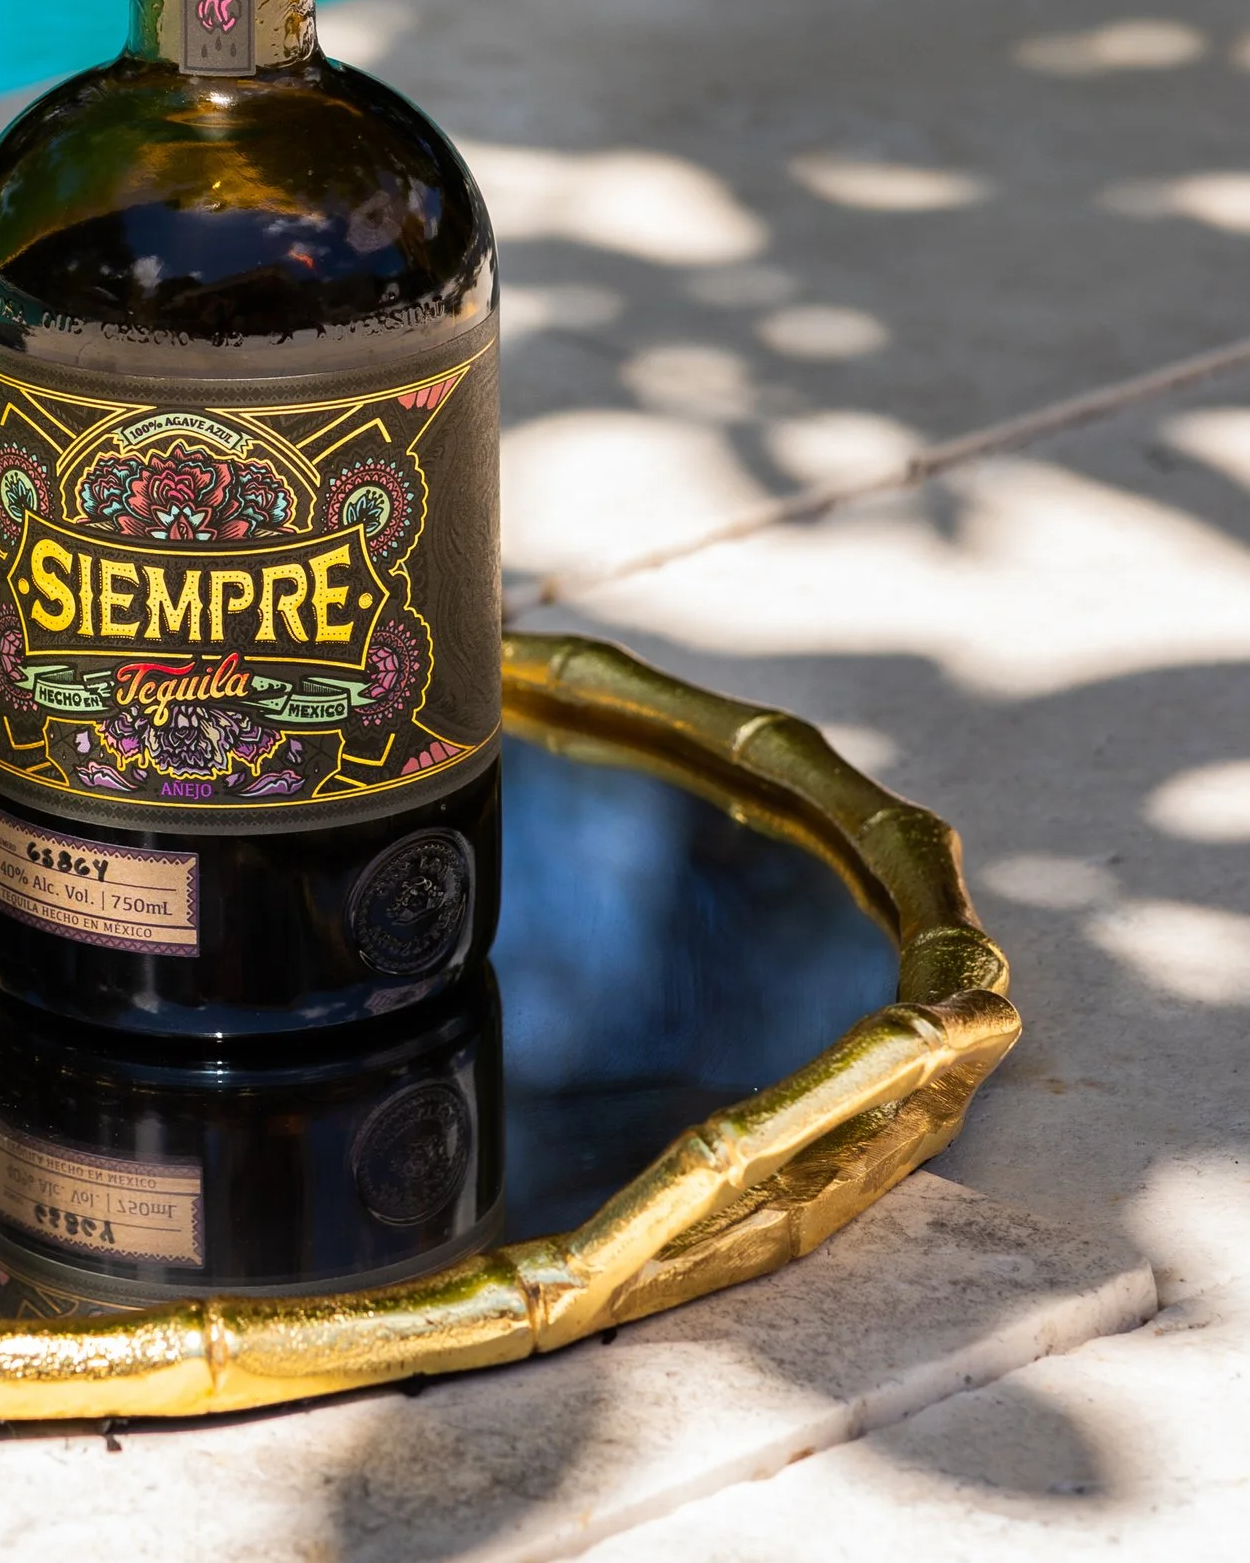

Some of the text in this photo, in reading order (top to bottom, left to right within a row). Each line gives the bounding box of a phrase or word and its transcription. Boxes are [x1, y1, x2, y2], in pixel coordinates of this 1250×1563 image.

[130, 416, 234, 444] 100% AGAVE AZUL
[30, 538, 356, 646] SIEMPRE
[38, 687, 102, 709] HECHO EN
[115, 652, 251, 726] Tequila
[287, 701, 347, 719] MEXICO
[161, 779, 213, 800] AÑEJO
[0, 859, 95, 905] 40% Alc. Vol.
[2, 889, 39, 914] TEQUILA
[42, 907, 79, 925] HECHO
[83, 918, 99, 930] EN
[103, 921, 152, 938] MÉXICO
[111, 894, 173, 916] 750mL
